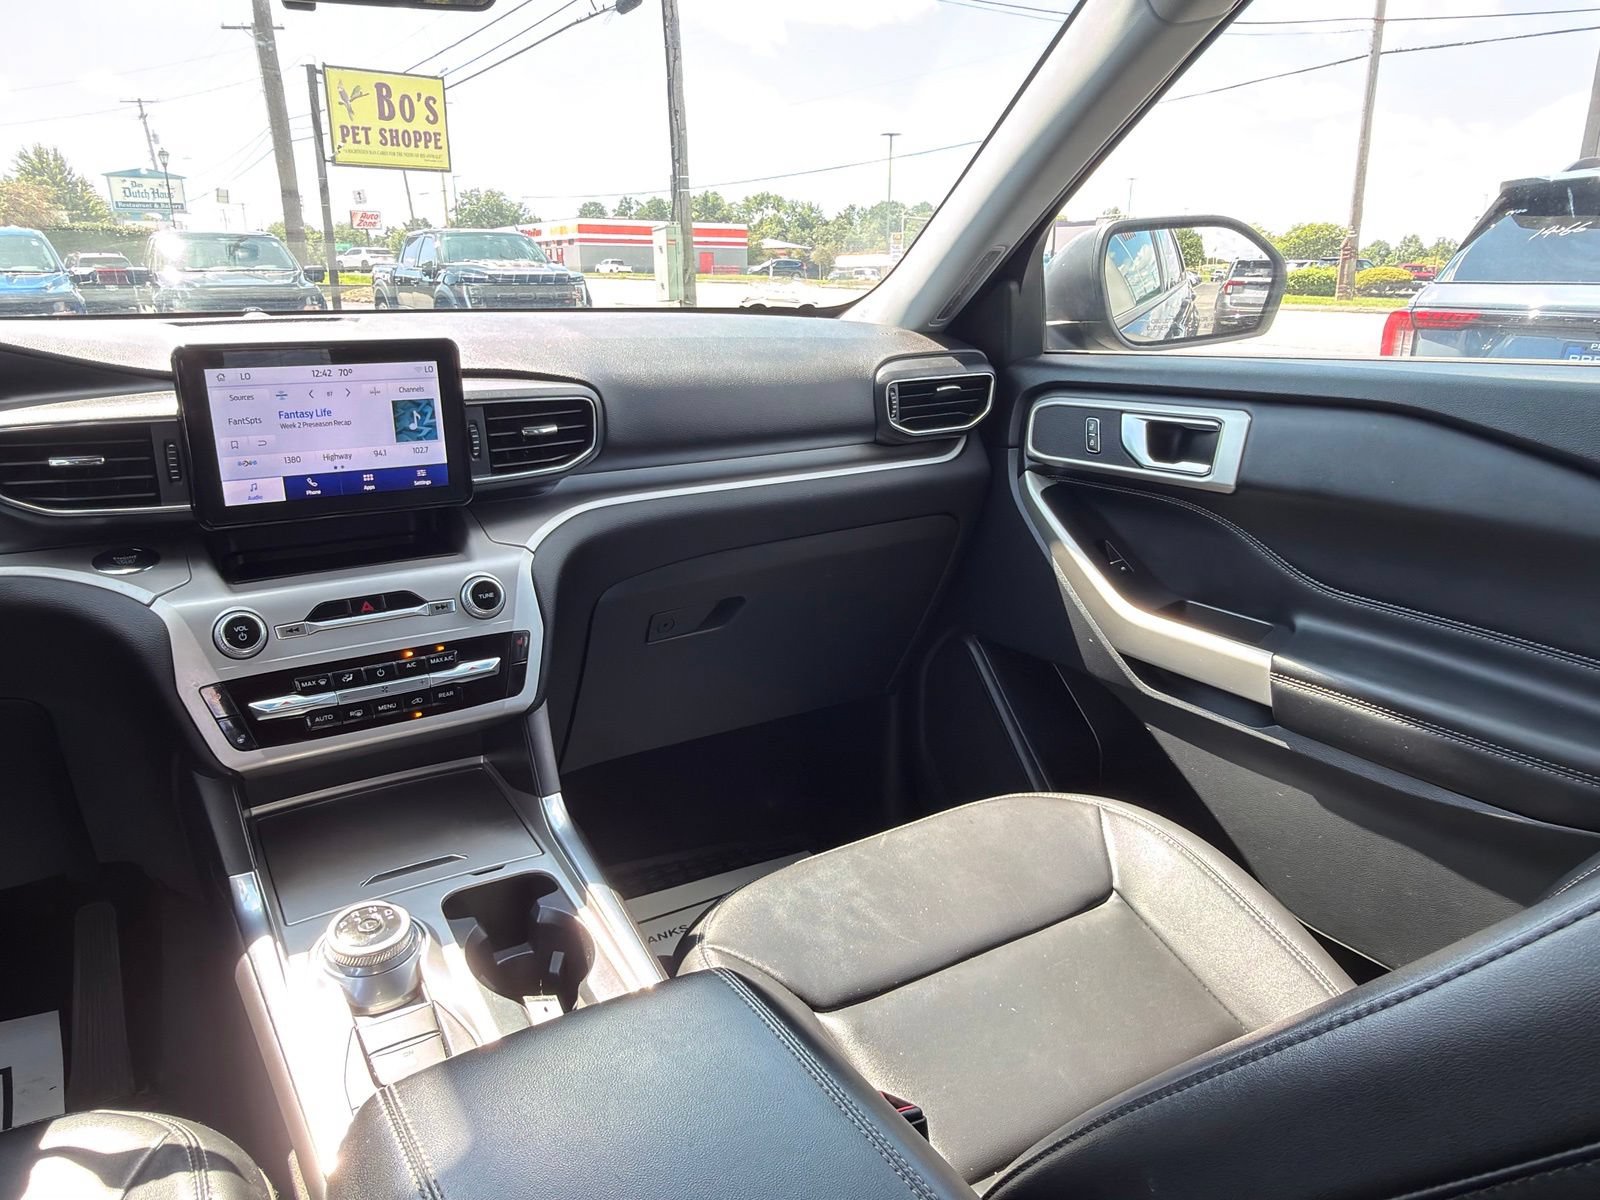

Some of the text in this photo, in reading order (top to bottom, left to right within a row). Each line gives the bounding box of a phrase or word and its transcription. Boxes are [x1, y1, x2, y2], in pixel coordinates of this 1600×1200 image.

[339, 125, 443, 150] PET SHOPPE
[121, 187, 149, 200] Dutch
[360, 212, 379, 220] Auto
[357, 219, 377, 227] Zone
[311, 369, 333, 378] 12:42
[424, 365, 434, 374] LO
[240, 372, 251, 381] LO
[398, 385, 425, 393] Channels
[228, 394, 255, 402] Sources
[278, 408, 333, 420] Fantasy Life
[228, 416, 263, 426] FantSpts
[280, 419, 352, 429] Week 2 Preseason Recap
[373, 449, 388, 457] 94.1
[412, 446, 430, 454] 102.7
[284, 456, 302, 464] 1380
[323, 453, 353, 462] Highway
[233, 625, 248, 633] VOL
[429, 655, 455, 665] MAX A/C
[405, 661, 417, 669] A/C
[301, 680, 317, 689] MAX
[438, 690, 454, 699] REAR
[377, 702, 398, 711] MENU
[314, 714, 334, 723] AUTO
